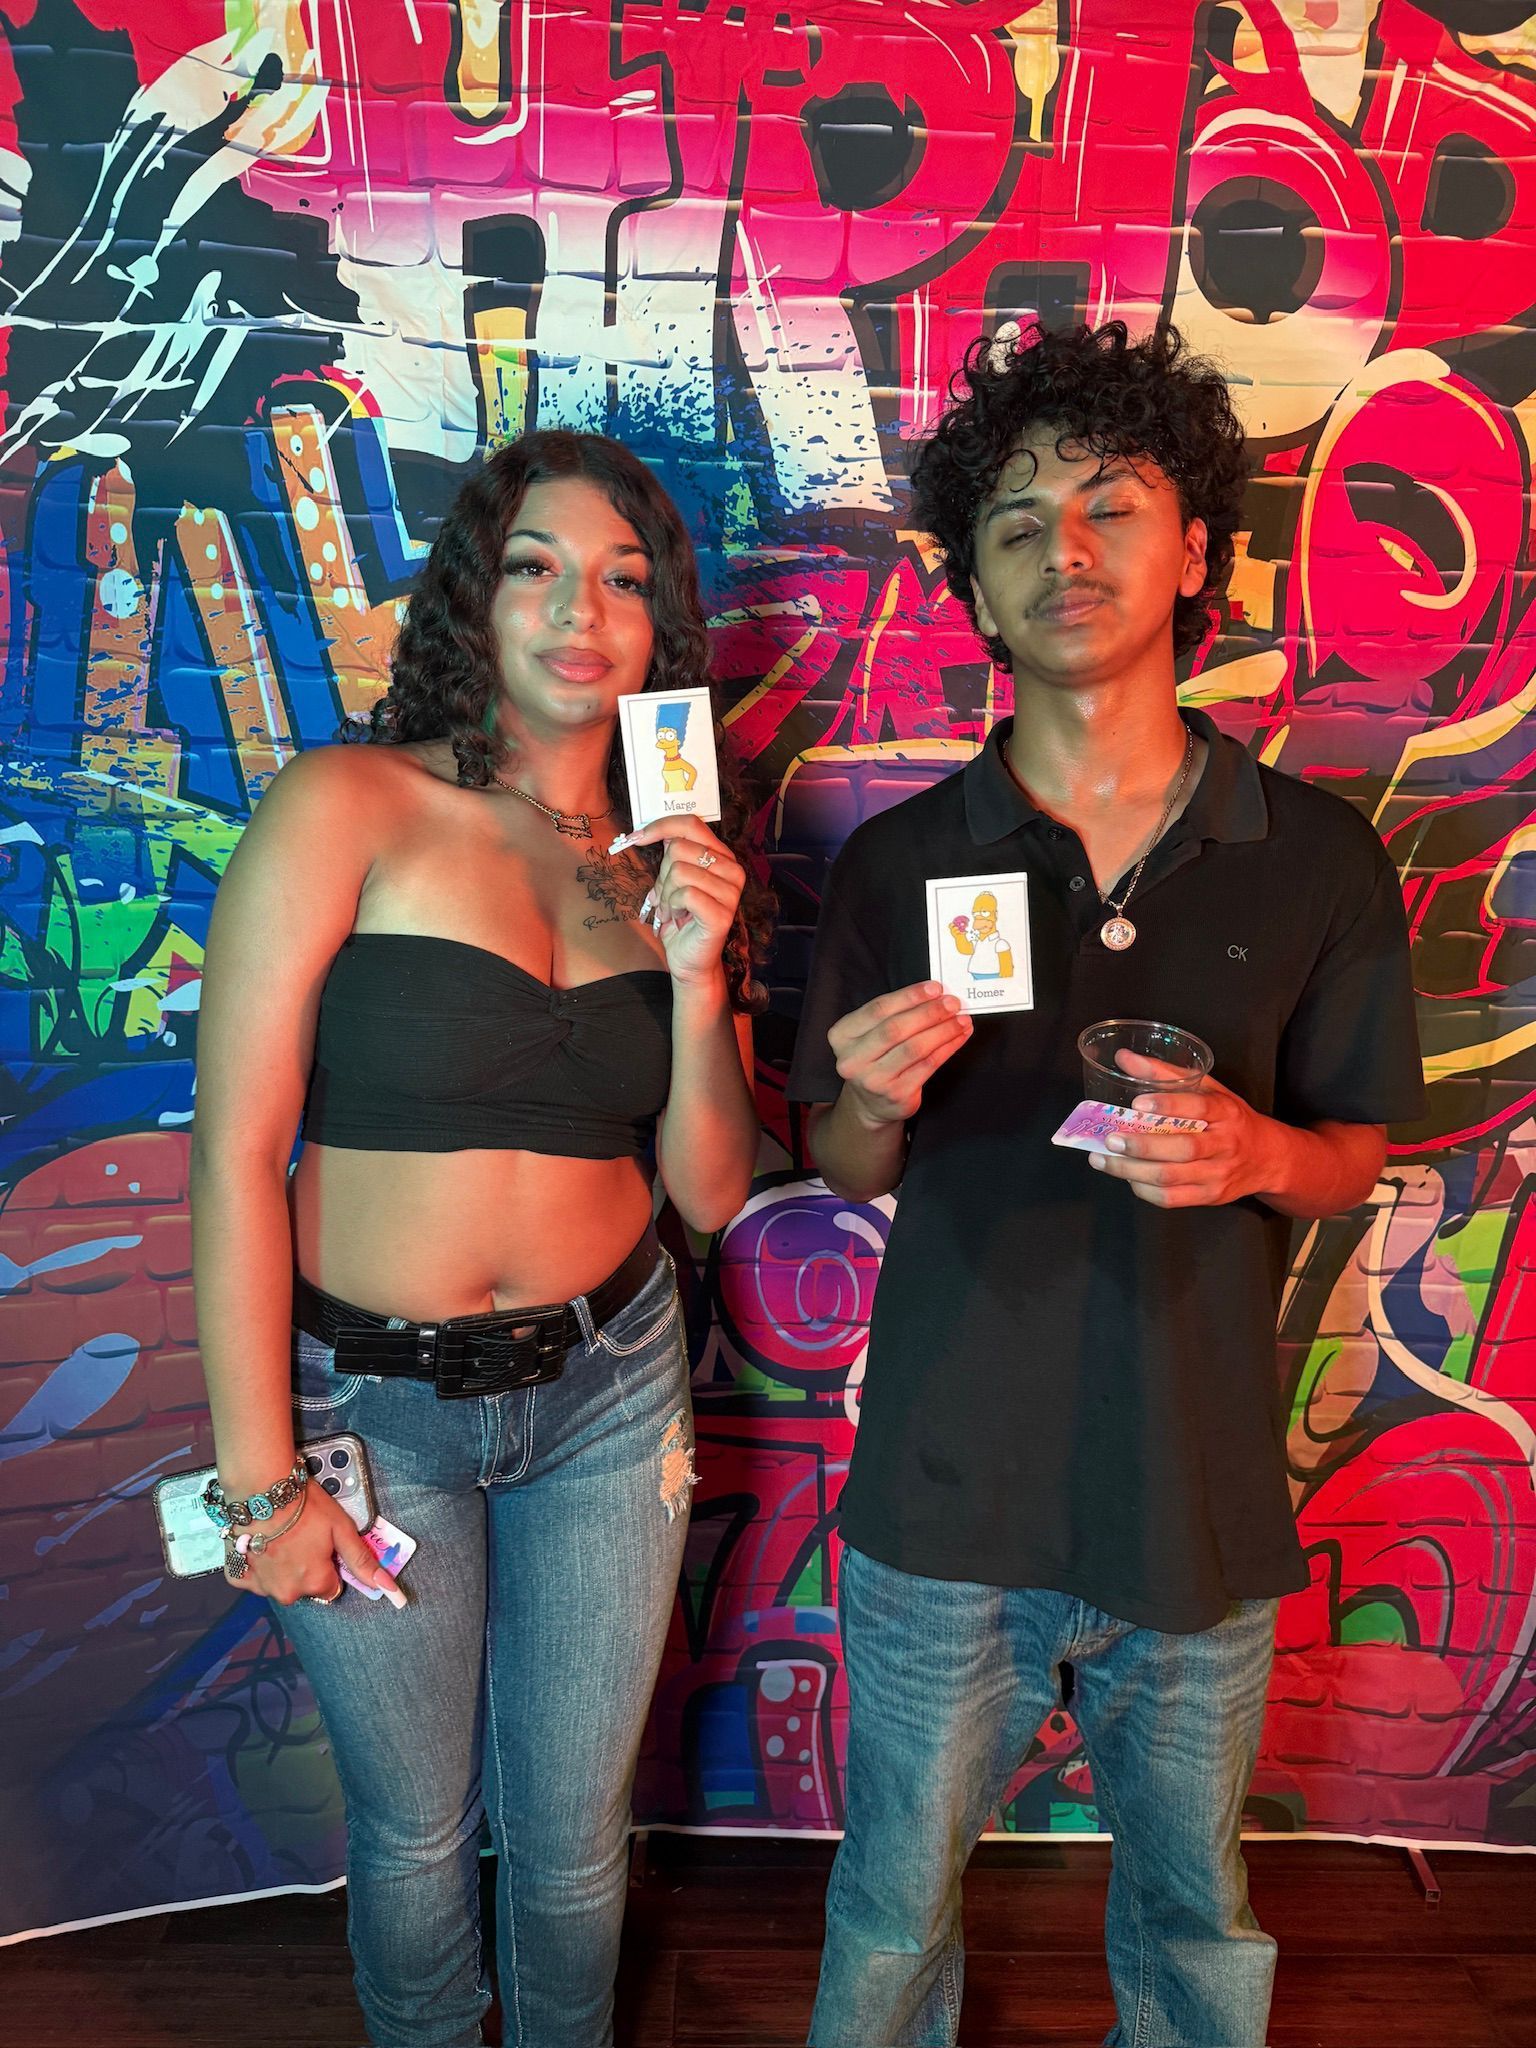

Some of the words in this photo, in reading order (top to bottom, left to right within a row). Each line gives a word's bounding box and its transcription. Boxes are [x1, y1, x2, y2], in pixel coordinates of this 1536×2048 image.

[663, 799, 697, 812] Marge
[1227, 944, 1249, 962] CK
[967, 987, 1005, 999] Homer
